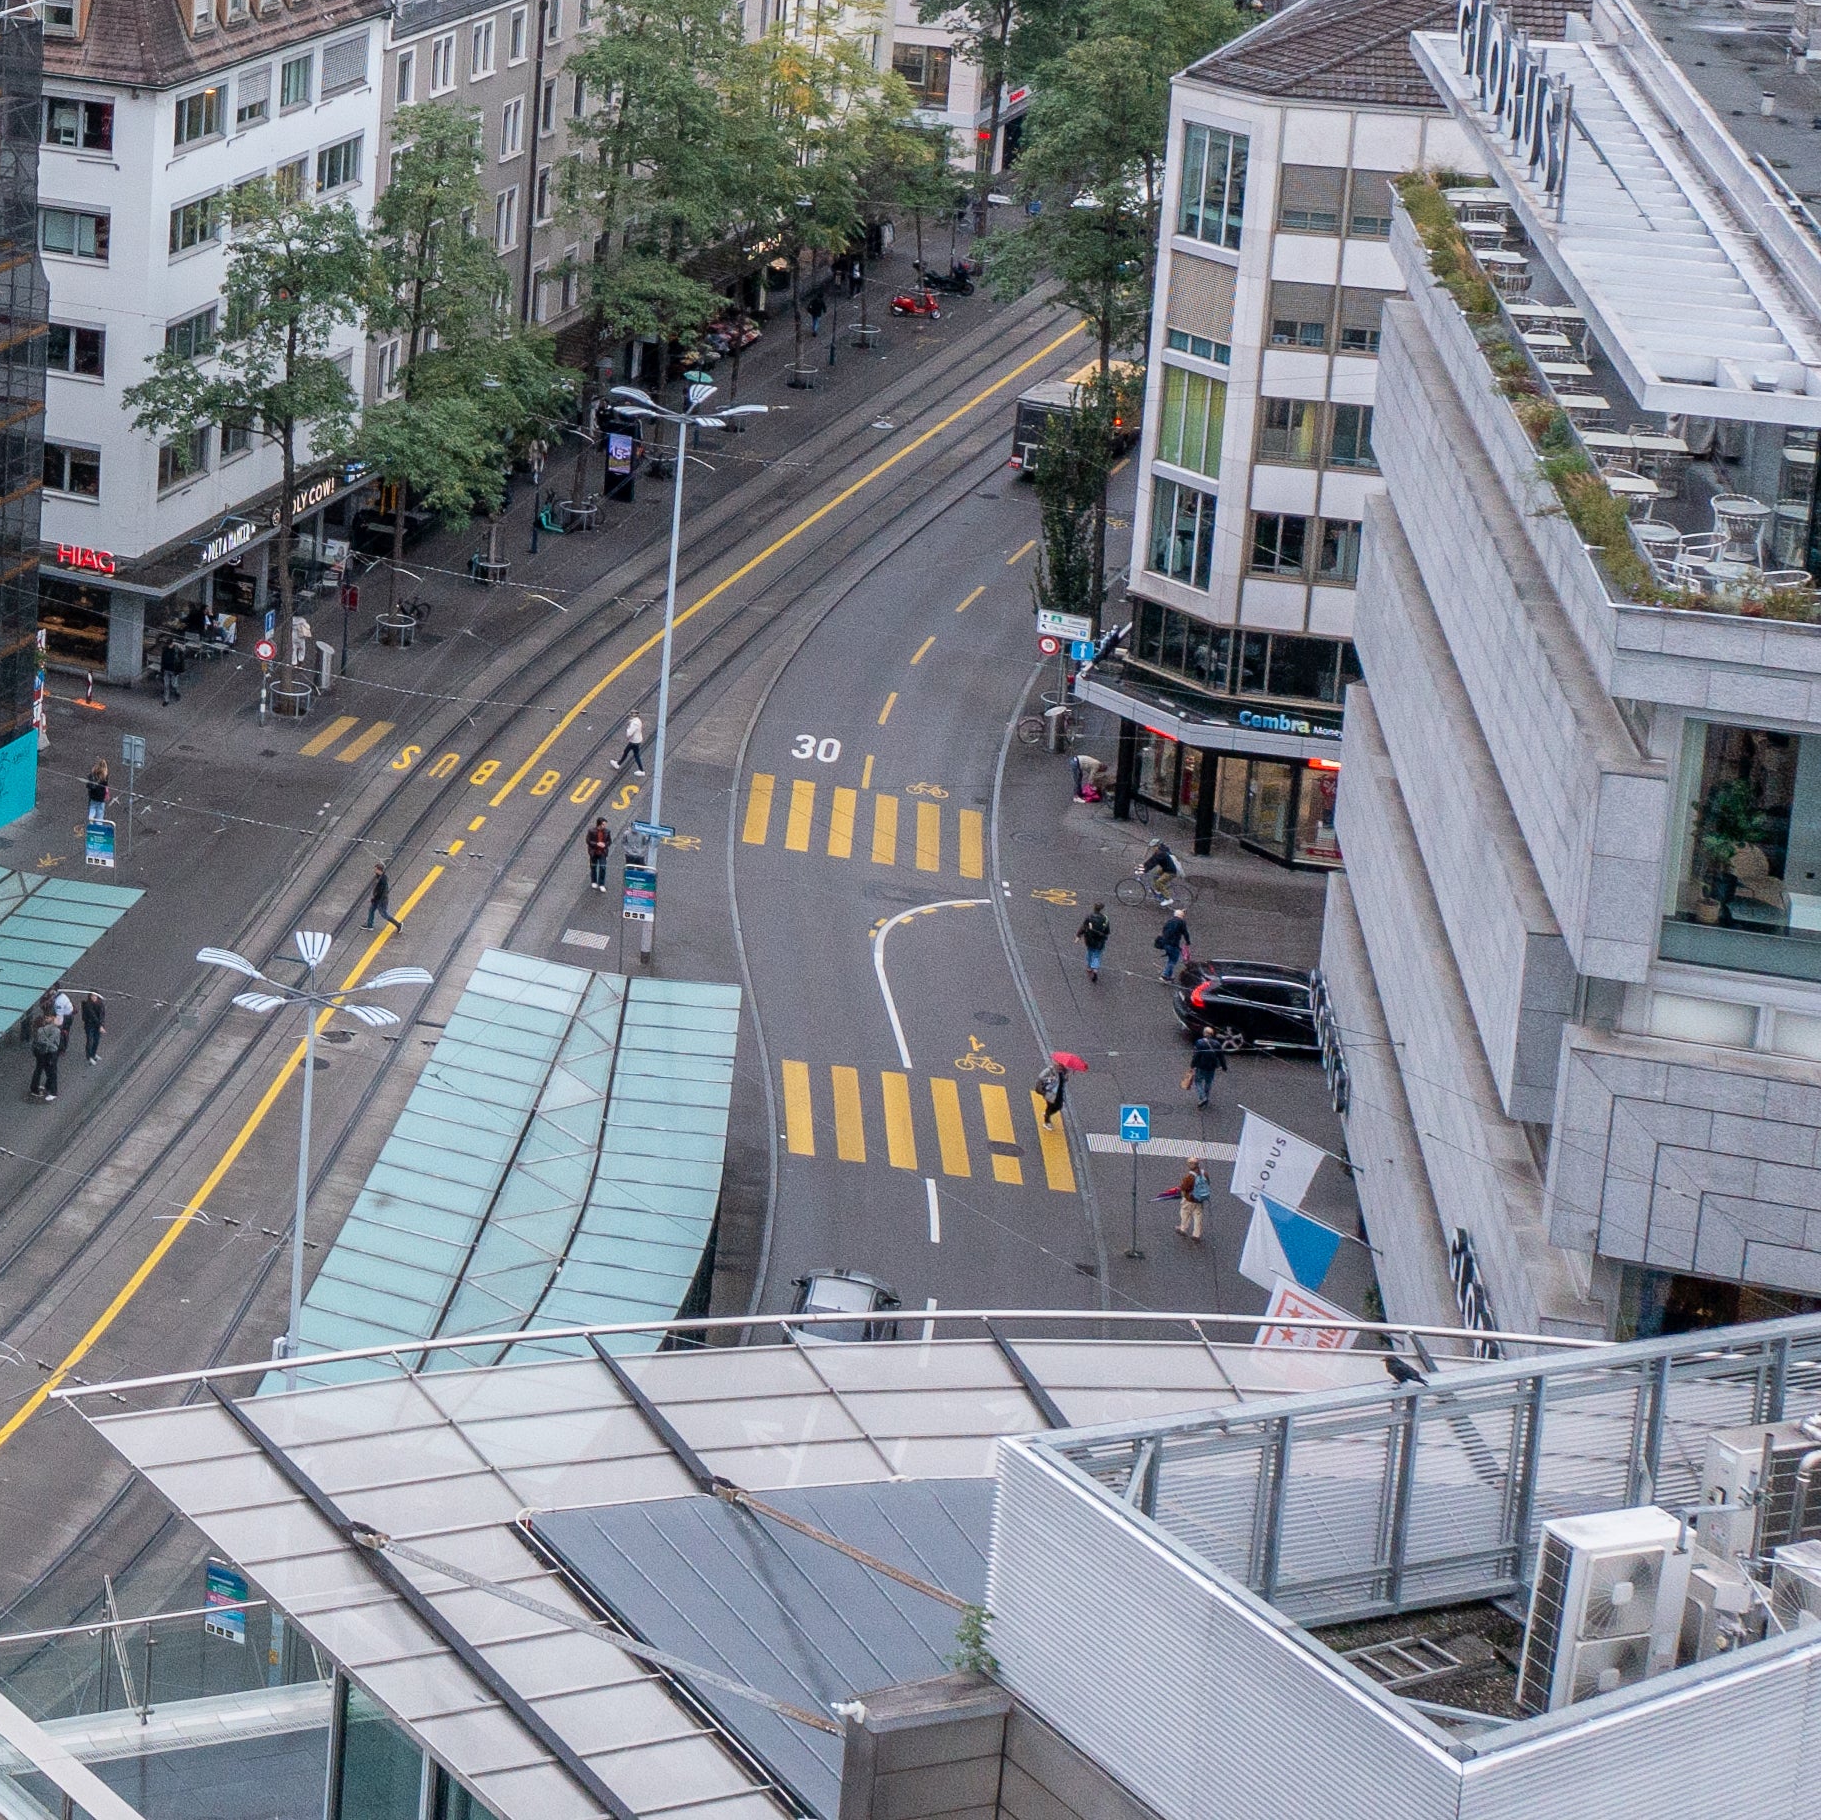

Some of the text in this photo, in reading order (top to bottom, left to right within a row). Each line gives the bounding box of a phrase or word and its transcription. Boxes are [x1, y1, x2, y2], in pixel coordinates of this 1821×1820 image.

[308, 477, 335, 506] COW!
[58, 542, 116, 574] HIAG
[1239, 710, 1311, 734] Cembra
[791, 734, 842, 763] 30
[391, 745, 502, 786] BUS
[529, 769, 640, 811] BUS
